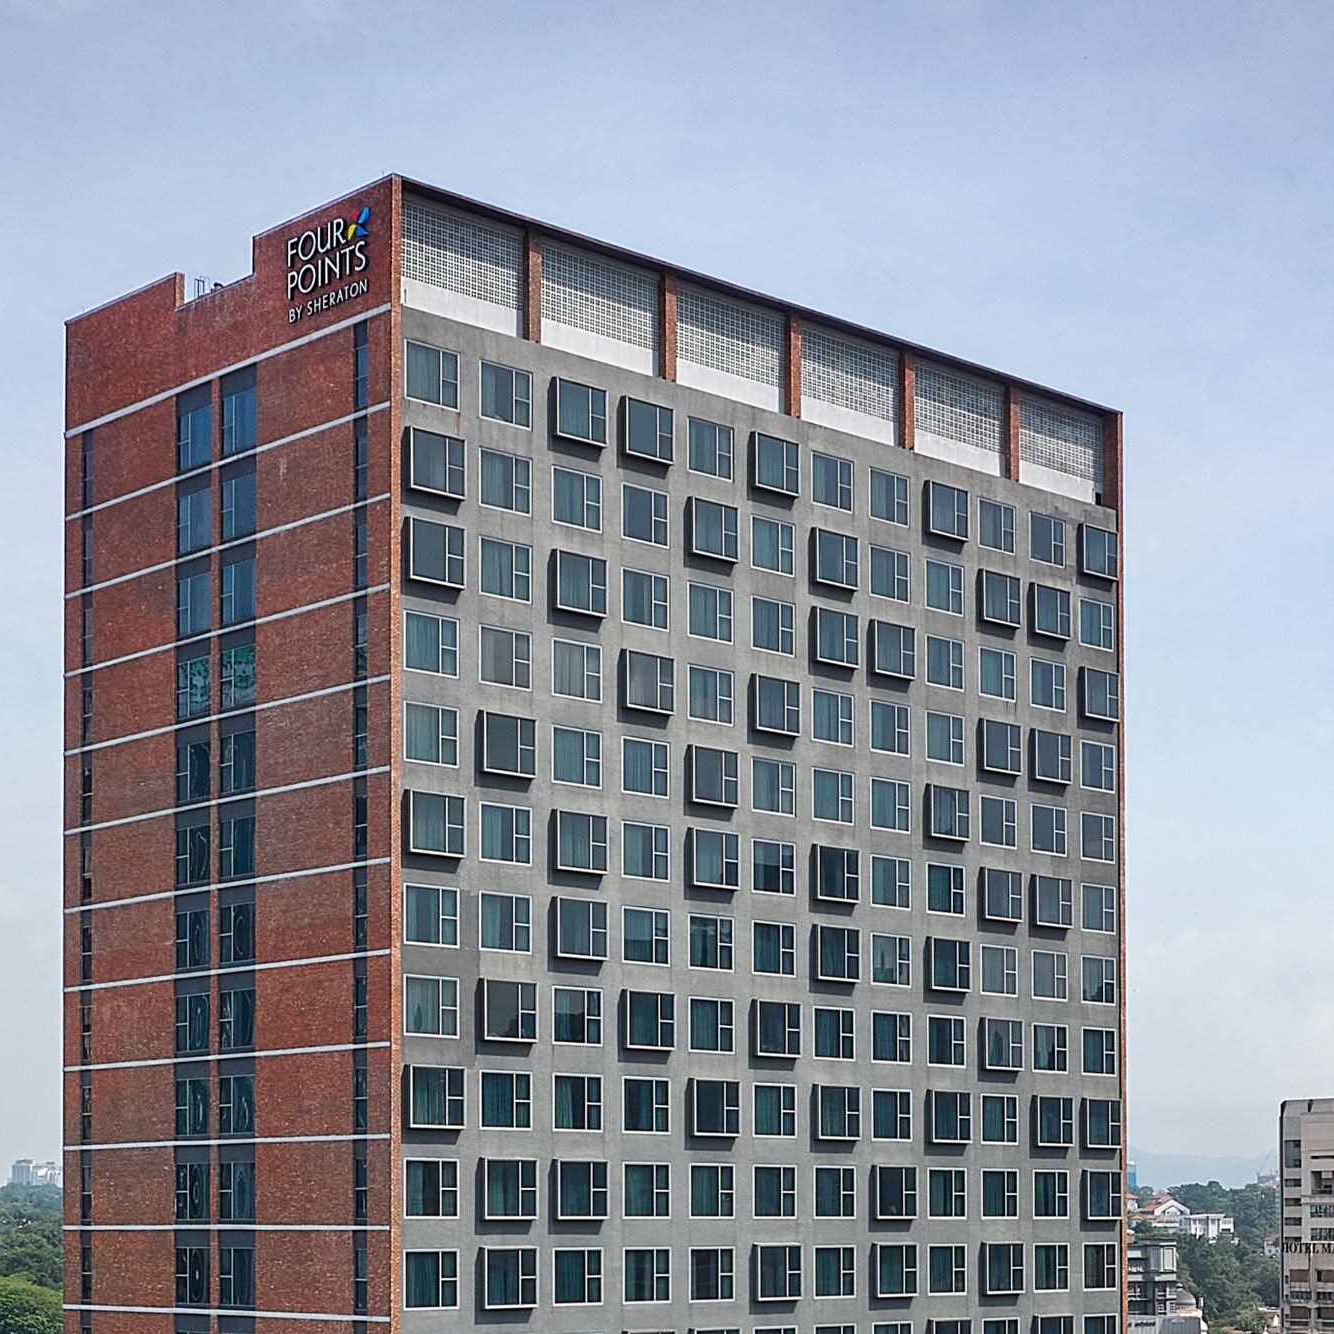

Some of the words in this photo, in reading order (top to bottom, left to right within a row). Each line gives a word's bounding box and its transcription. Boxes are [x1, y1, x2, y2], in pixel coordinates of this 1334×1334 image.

[287, 218, 346, 267] FOUR
[287, 241, 366, 300] POINTS
[288, 305, 303, 323] BY
[307, 278, 368, 316] SHERATON
[1283, 1242, 1319, 1254] HOTEL
